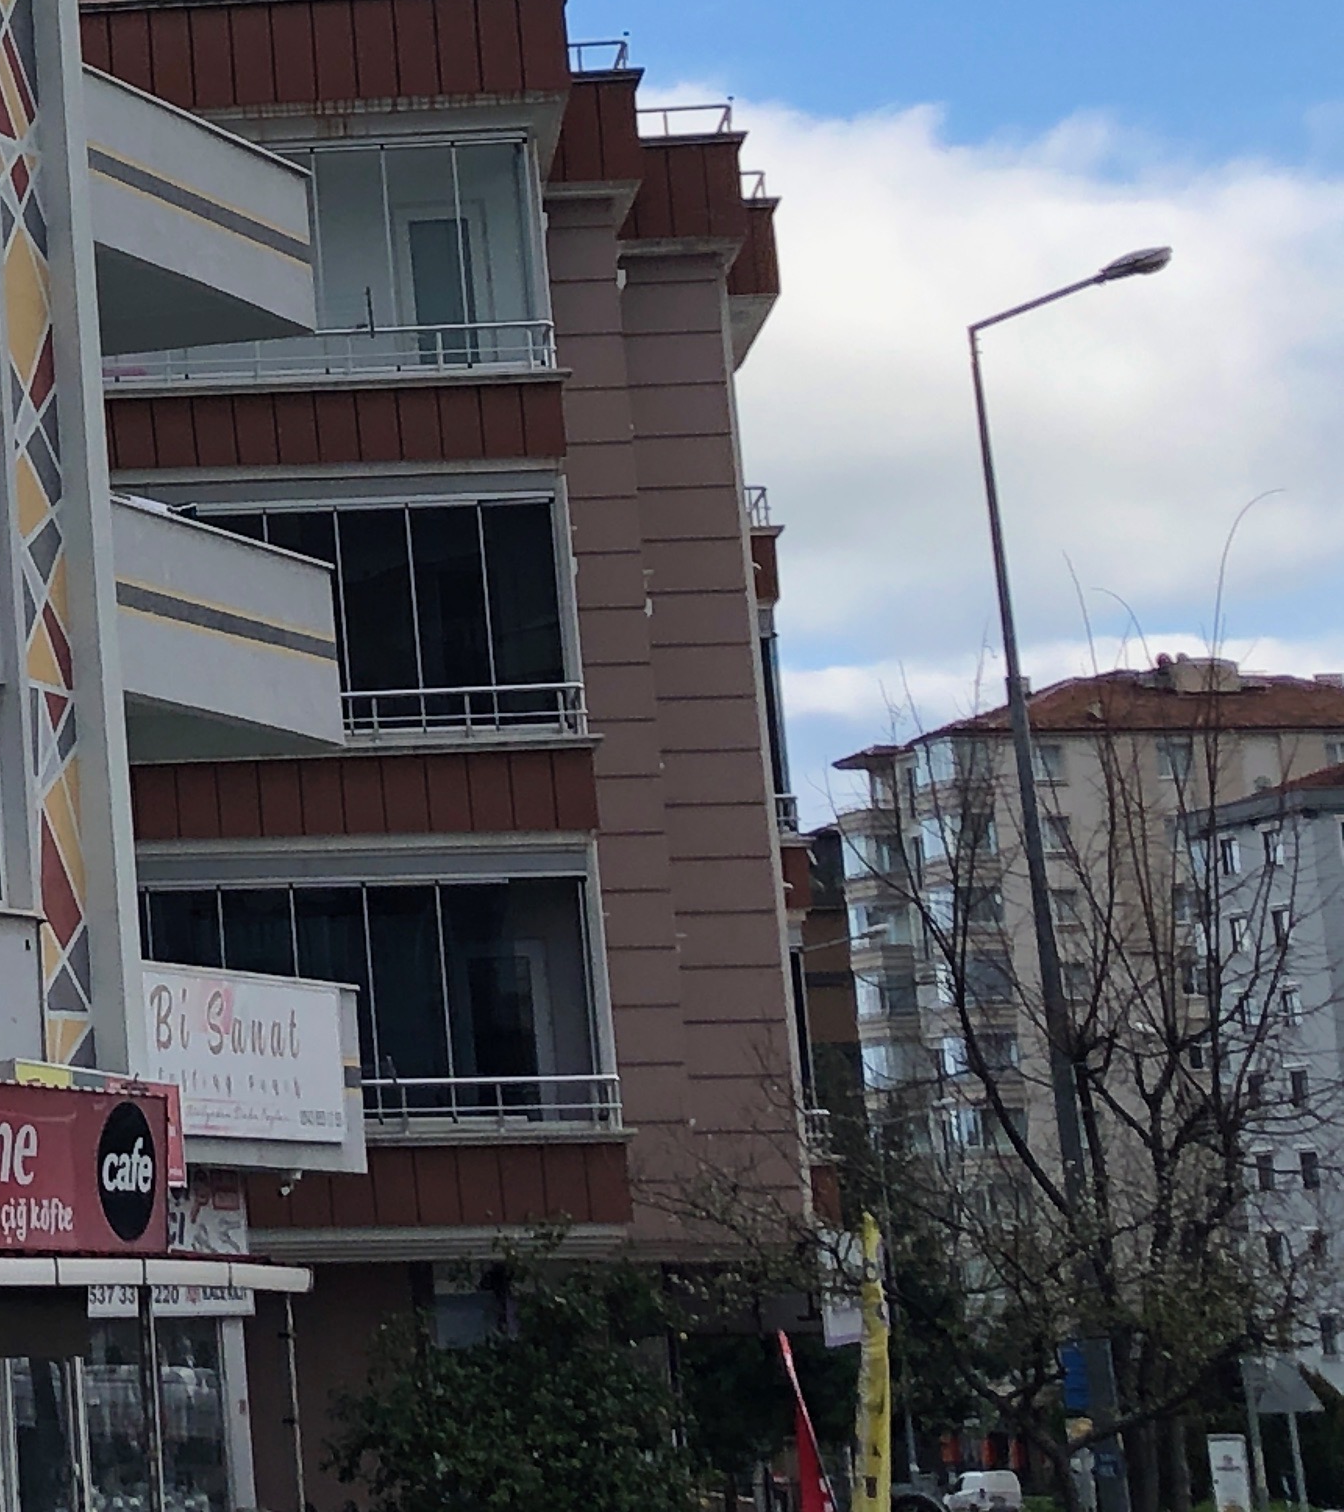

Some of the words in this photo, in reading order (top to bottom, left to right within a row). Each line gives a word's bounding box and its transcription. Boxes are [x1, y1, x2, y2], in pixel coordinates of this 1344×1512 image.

[150, 984, 190, 1052] Bi
[207, 990, 301, 1059] Sanat
[102, 1136, 153, 1193] cafe
[1, 1197, 27, 1244] çiğ
[30, 1197, 74, 1236] köfte
